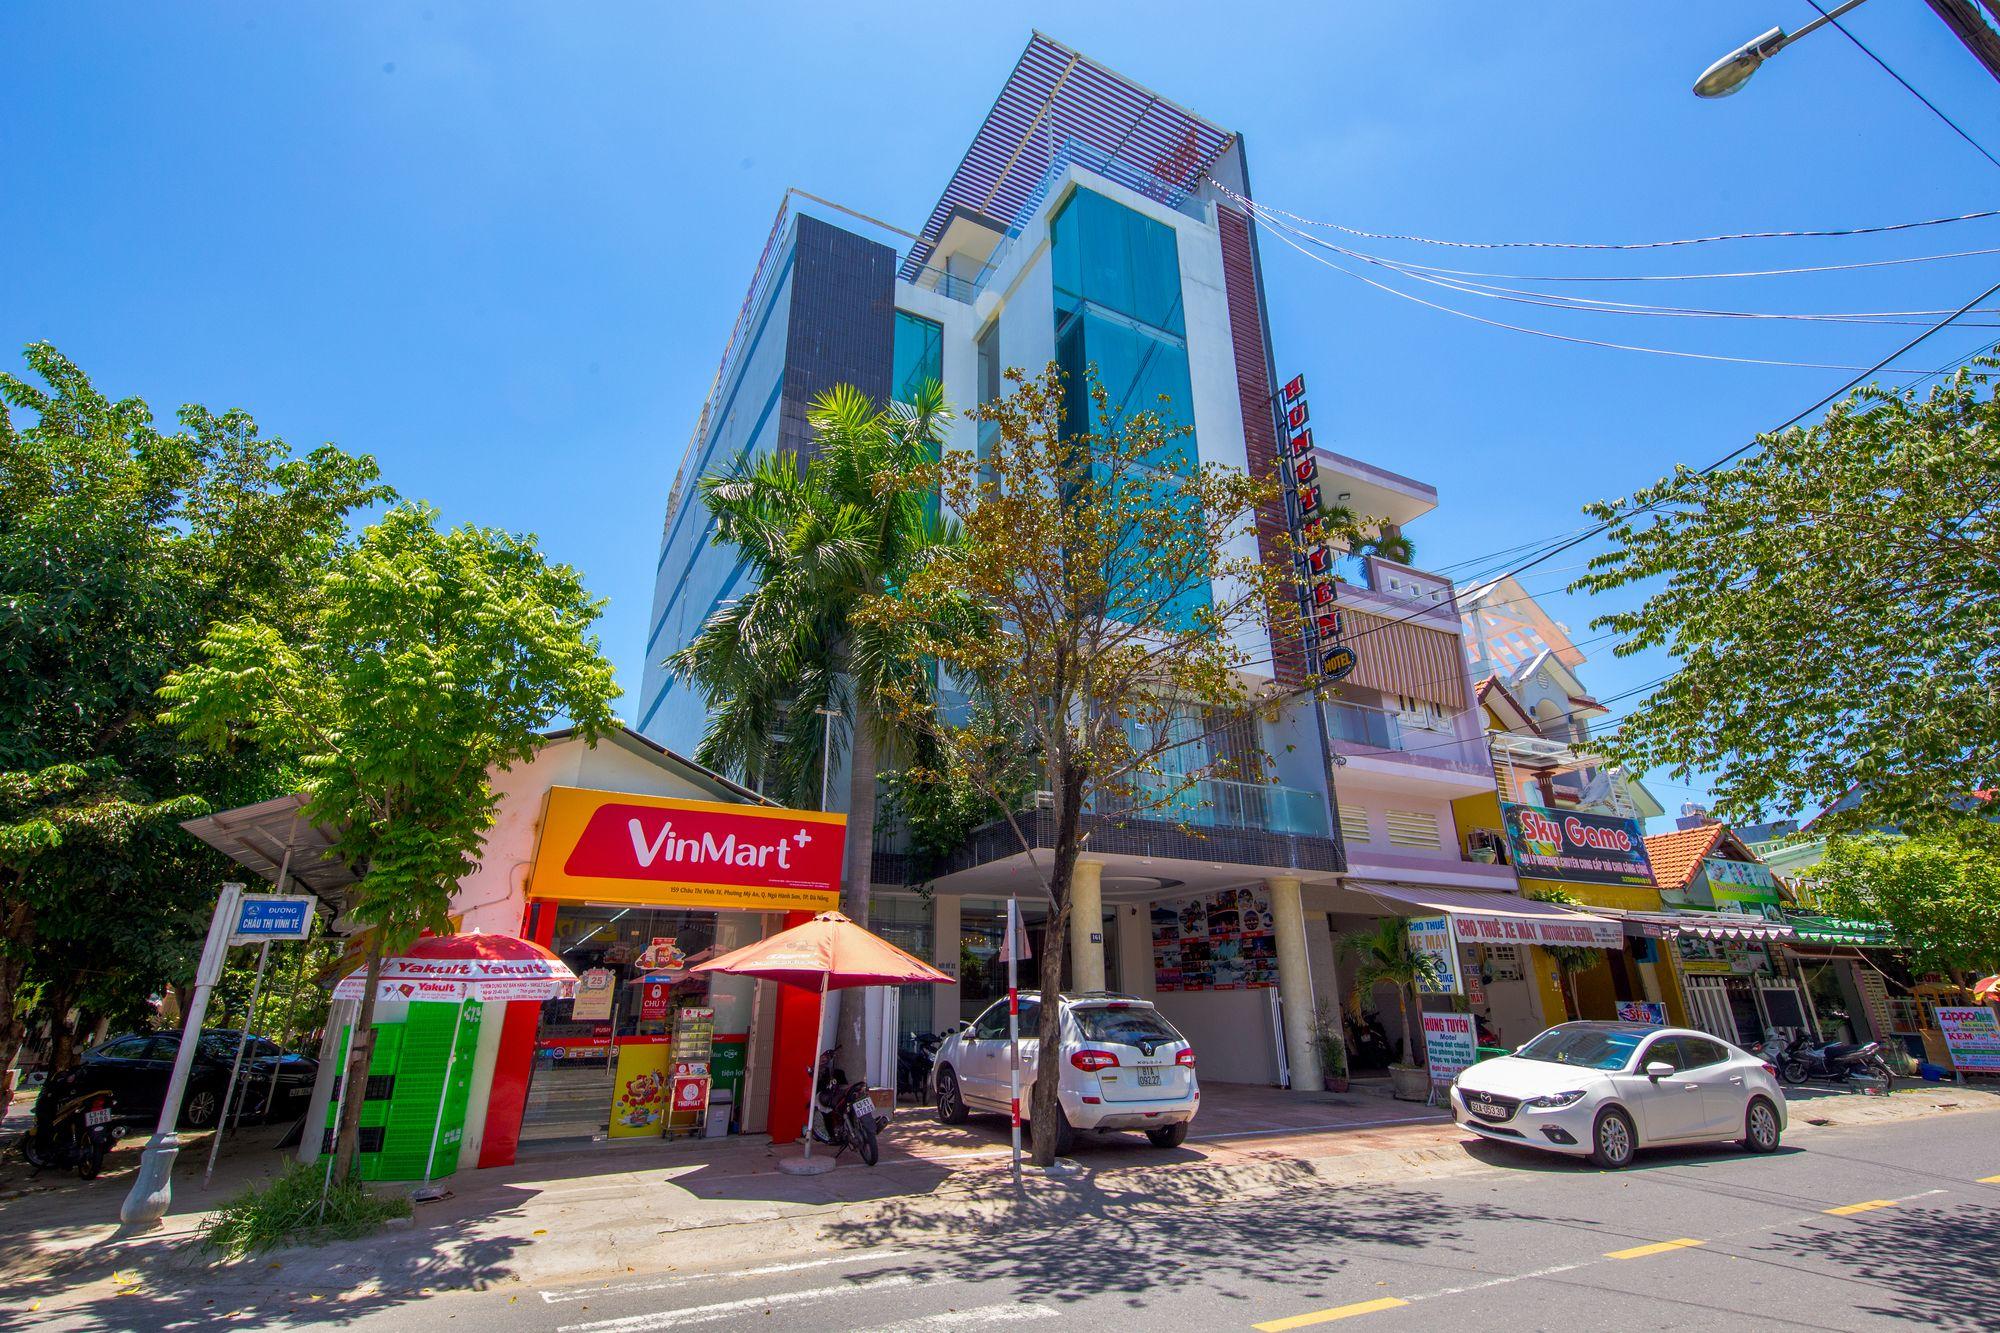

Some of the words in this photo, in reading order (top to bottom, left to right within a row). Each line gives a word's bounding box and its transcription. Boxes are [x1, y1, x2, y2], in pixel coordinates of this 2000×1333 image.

[1323, 651, 1351, 674] HOTEL
[1520, 811, 1563, 852] Sky
[1564, 816, 1632, 852] Game
[242, 917, 262, 929] CHÂU
[262, 918, 273, 931] THỊ
[1408, 921, 1424, 932] CHO
[1425, 918, 1446, 930] THUÊ
[1456, 918, 1478, 937] CHO
[1477, 917, 1503, 939] THUÊ
[1502, 921, 1517, 939] XE
[1515, 920, 1538, 940] MÁY
[1409, 935, 1422, 950] XE
[1425, 931, 1447, 949] MÁY
[398, 962, 472, 975] Yakult
[476, 962, 547, 975] Yakult
[591, 976, 603, 985] 25
[1415, 973, 1454, 983] MOBIKE
[418, 982, 455, 992] Yakult
[644, 998, 660, 1007] CHÚ
[661, 998, 667, 1007] Ý
[1424, 1015, 1445, 1032] HÙNG
[1948, 1032, 1973, 1041] KEM
